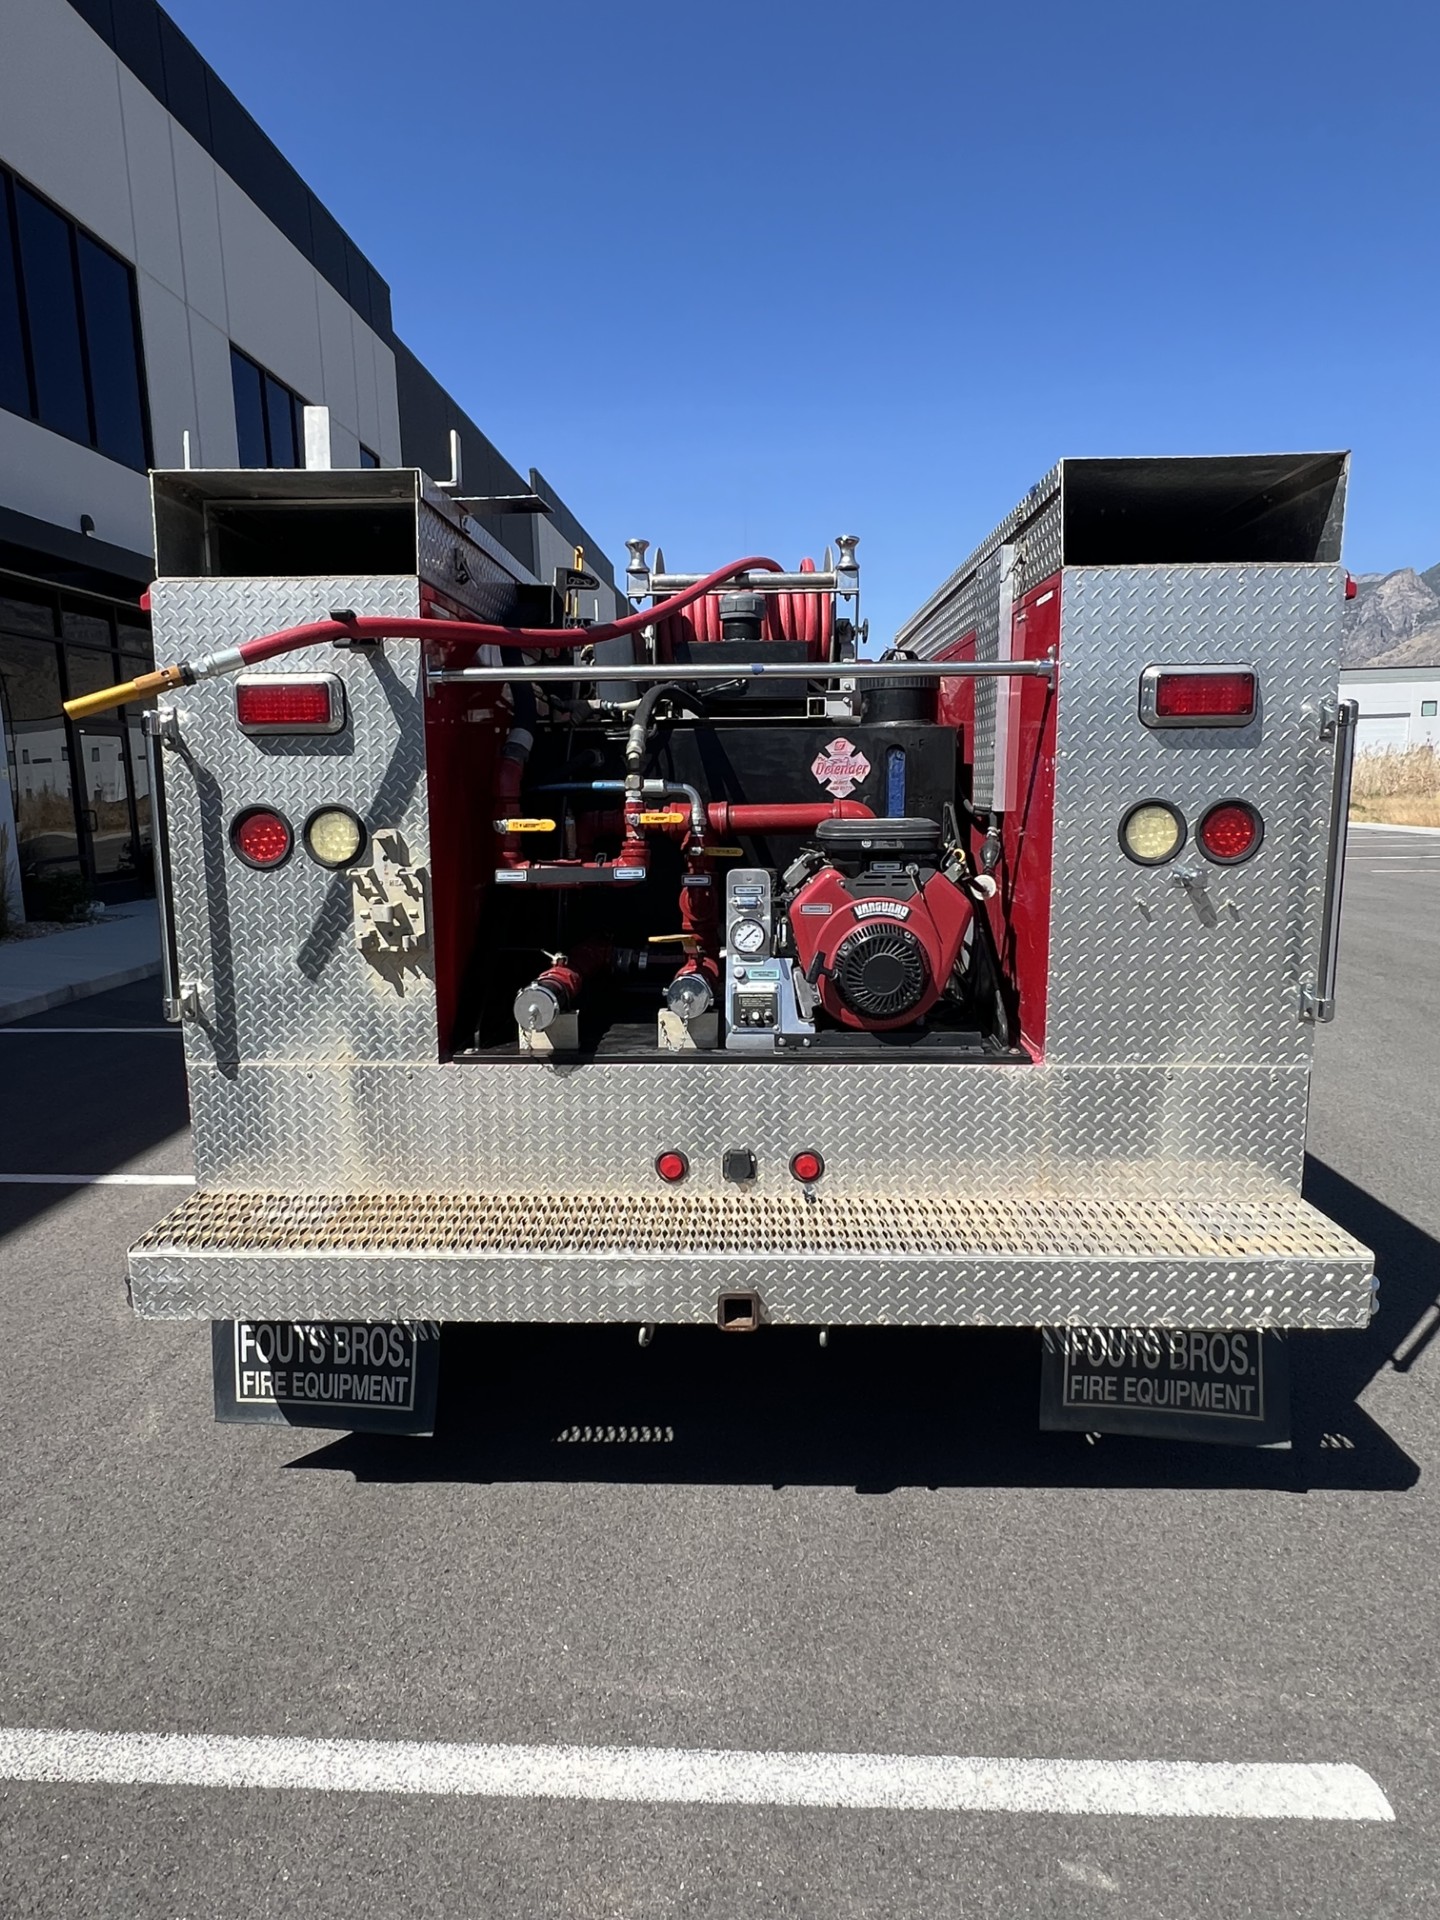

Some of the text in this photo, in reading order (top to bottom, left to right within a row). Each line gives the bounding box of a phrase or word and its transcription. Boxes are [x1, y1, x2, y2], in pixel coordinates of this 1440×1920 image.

[816, 762, 869, 776] Defender
[853, 901, 910, 917] VANGUARD
[241, 1325, 411, 1367] FOUTS BROS.
[1070, 1329, 1256, 1376] FOUTS BROS.
[243, 1371, 409, 1403] FIRE EQUIPMENT
[1071, 1375, 1255, 1411] FIRE EQUIPMENT
